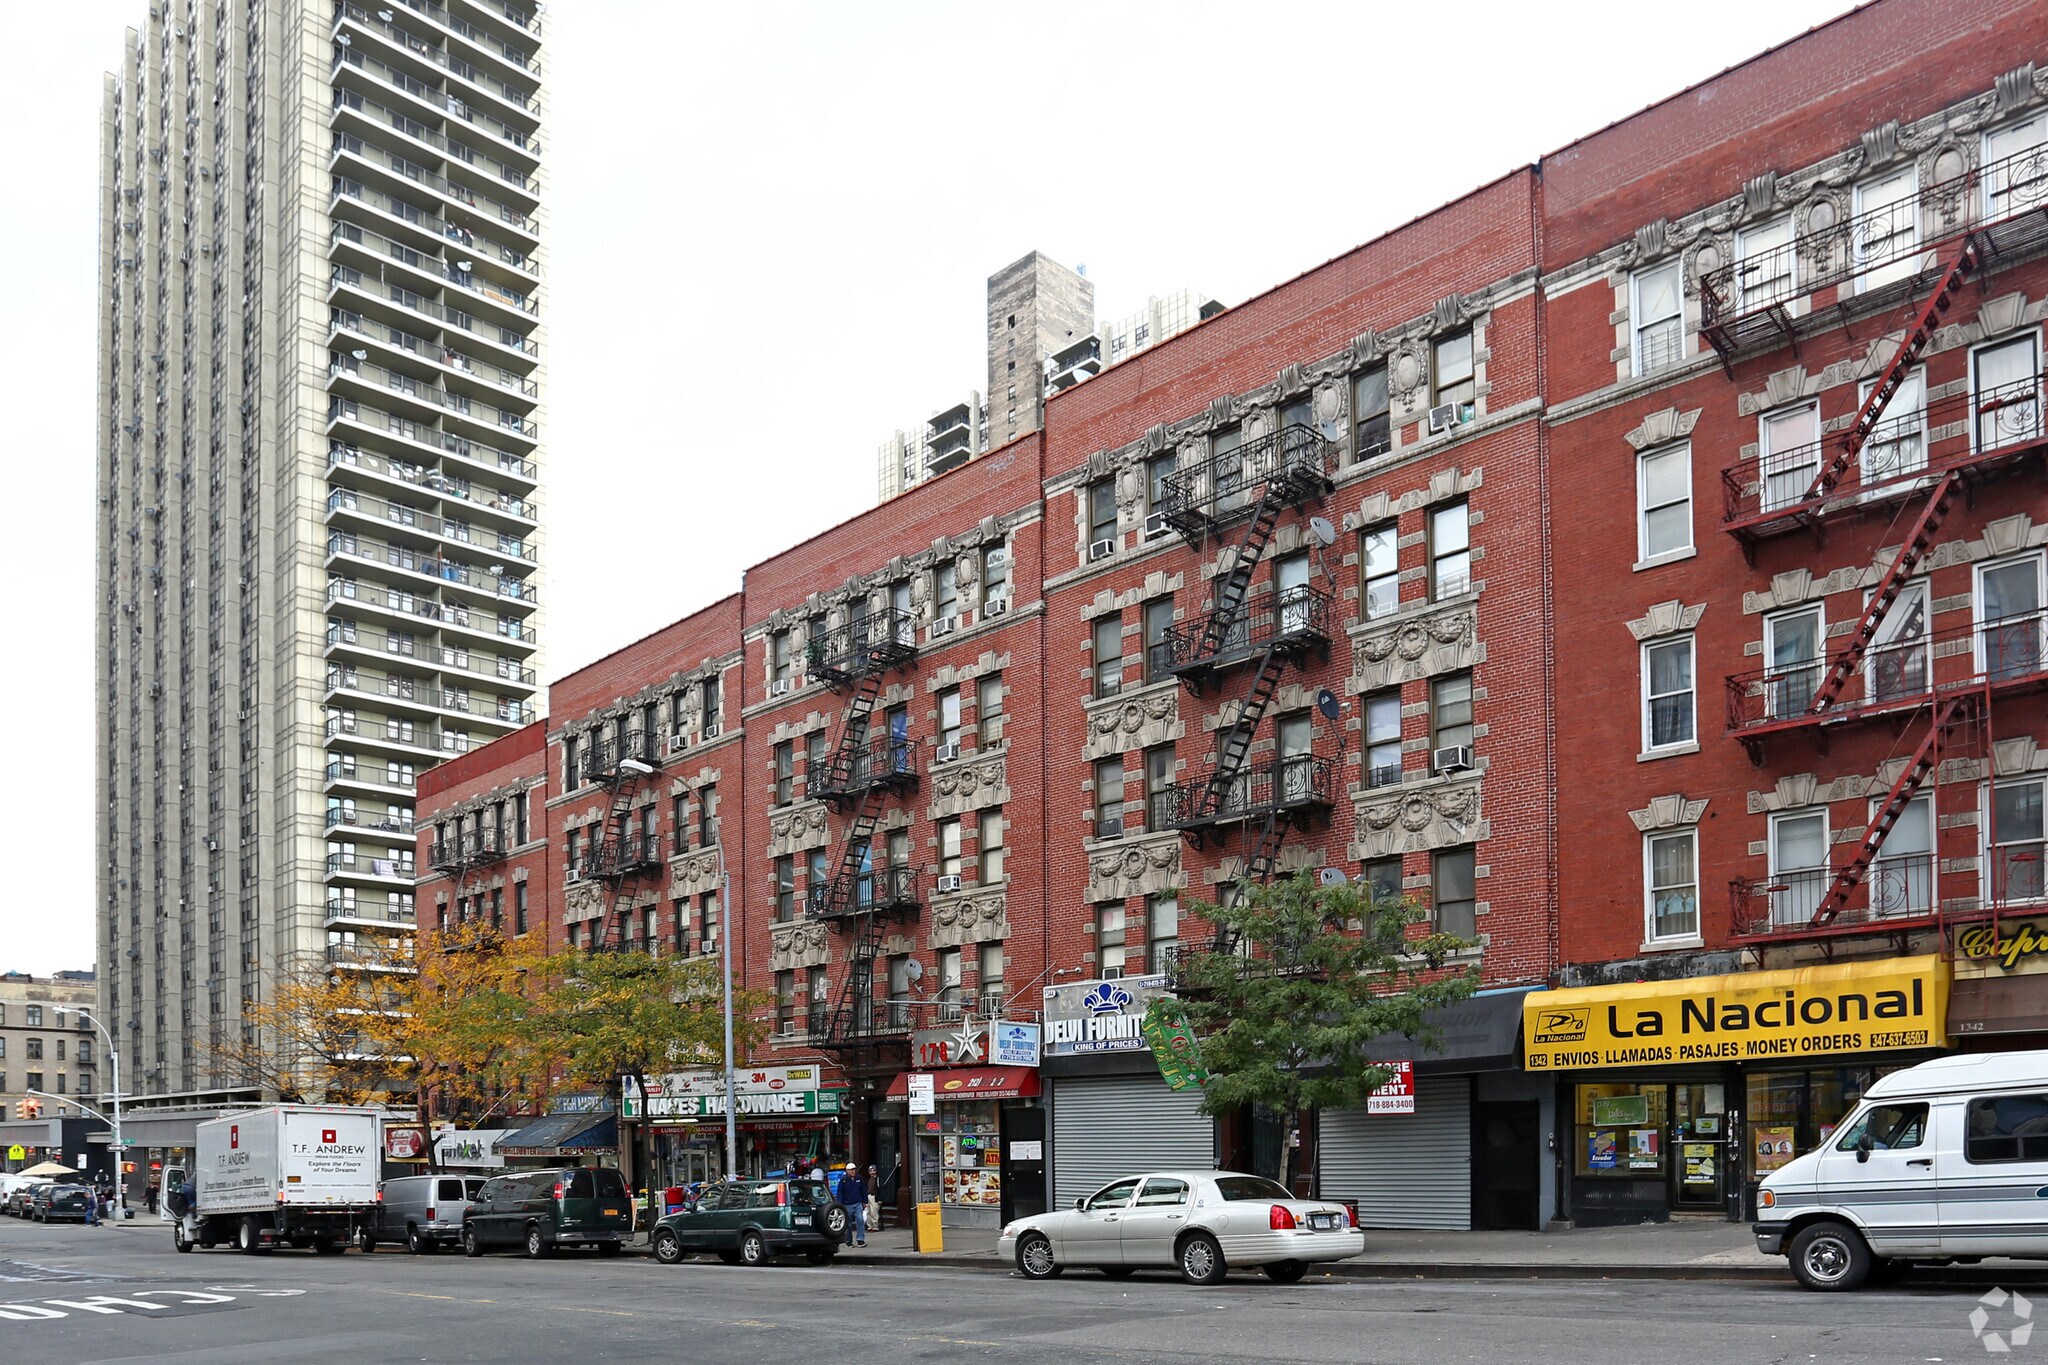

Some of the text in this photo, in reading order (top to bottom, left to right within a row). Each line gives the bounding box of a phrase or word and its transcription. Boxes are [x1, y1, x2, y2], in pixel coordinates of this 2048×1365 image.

[1608, 978, 1923, 1039] La Nacional
[1045, 1012, 1147, 1044] DELVI FURNIT
[1960, 1022, 1984, 1032] 1342
[1535, 1032, 1585, 1043] La Nacional
[1012, 1040, 1036, 1051] FURNITURE
[1074, 1039, 1139, 1052] KING OF PRICES
[1530, 1031, 1927, 1067] 1342 ENVIOS LLAMADAS PASAJES MONEY ORDERS 347-637-6503
[920, 1041, 948, 1063] 178
[751, 1072, 766, 1083] 3M
[644, 1086, 661, 1094] TANLEY
[563, 1095, 604, 1111] FISH MARKET
[629, 1097, 701, 1116] TNARES
[1368, 1100, 1414, 1109] 718-884-3400
[1608, 1108, 1624, 1118] bills
[962, 1137, 977, 1147] ATM
[292, 1144, 366, 1154] T.F. ANDREW
[218, 1152, 251, 1168] T.F. ANDREW
[985, 1153, 1000, 1165] ATM
